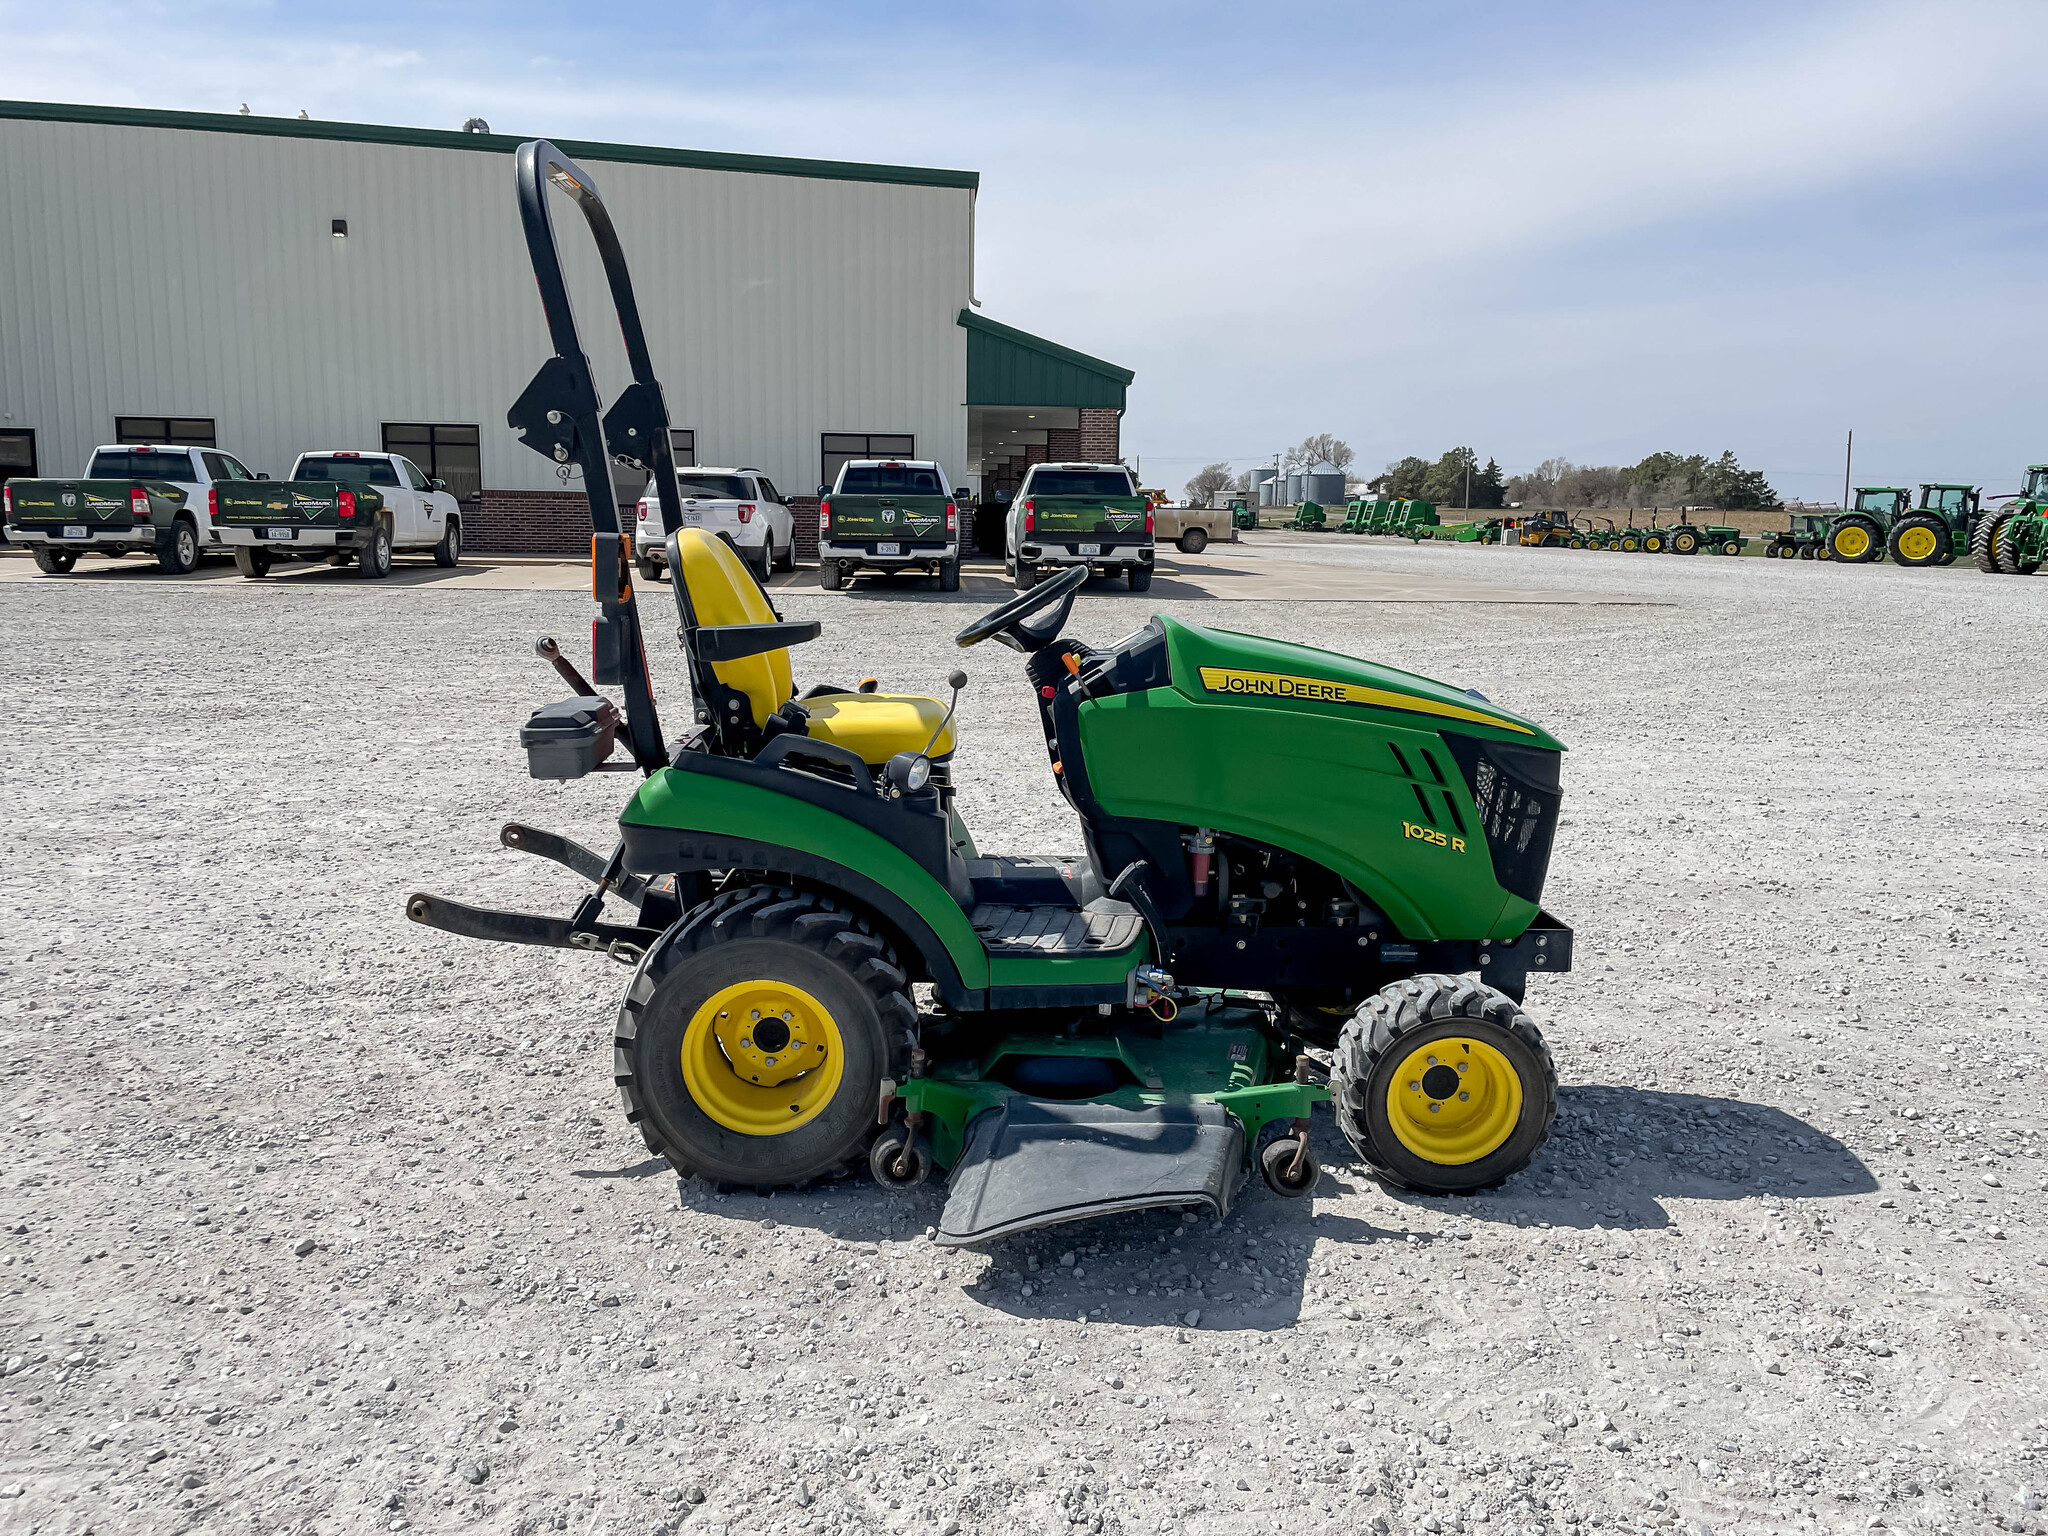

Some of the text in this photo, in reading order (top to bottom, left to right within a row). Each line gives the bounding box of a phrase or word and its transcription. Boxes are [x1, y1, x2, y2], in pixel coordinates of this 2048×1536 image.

[1218, 676, 1347, 700] JOHN DEERE
[1402, 821, 1447, 847] 1025
